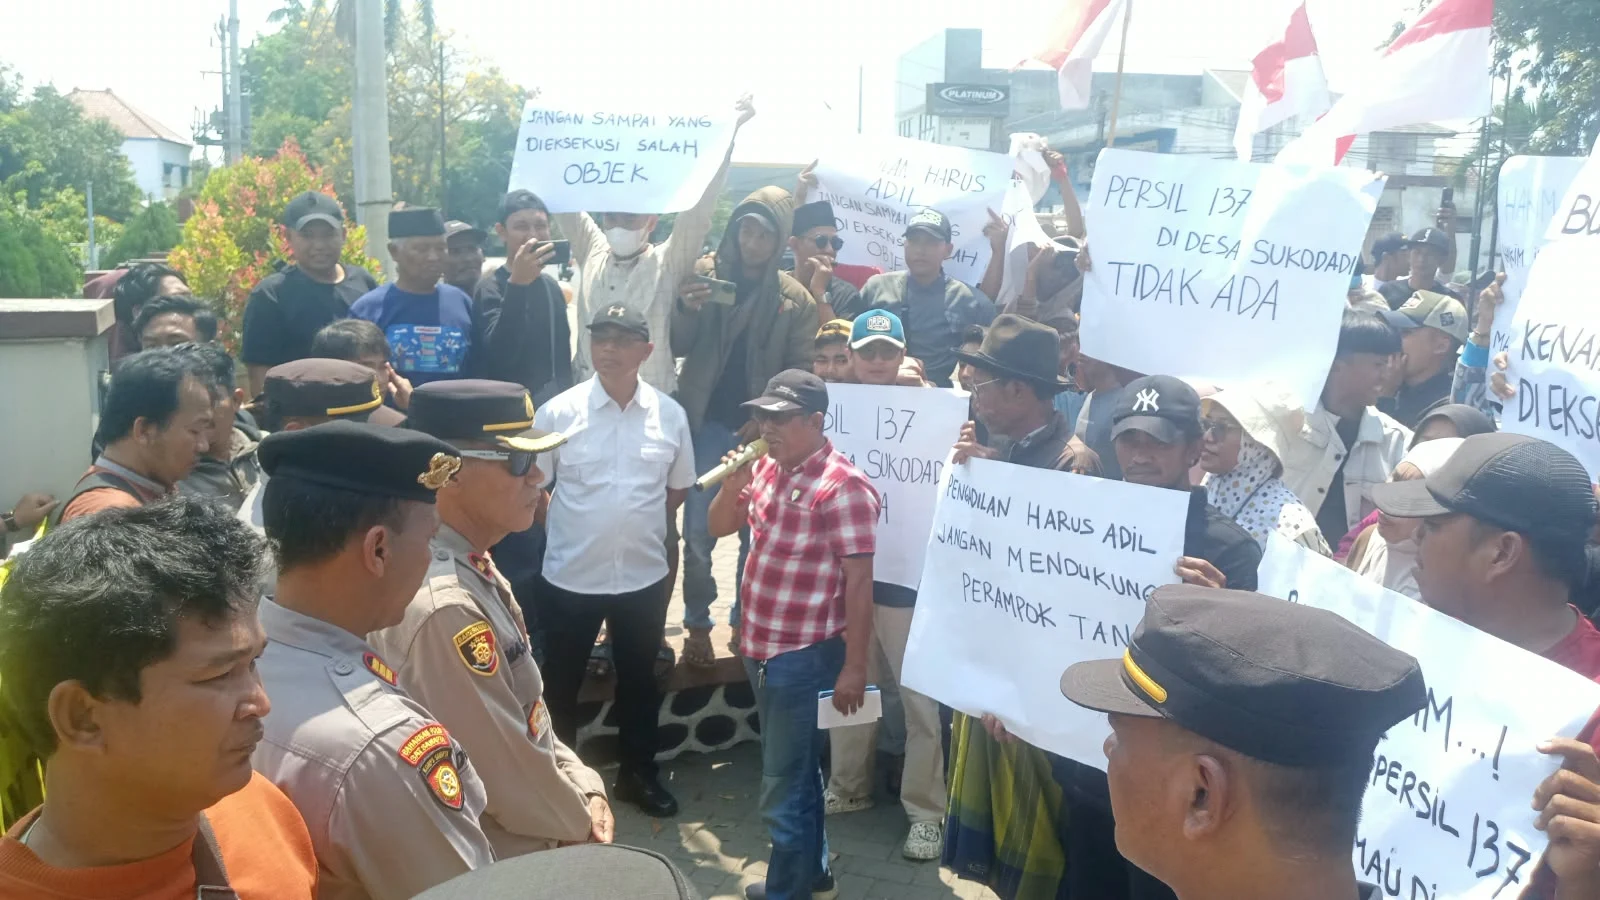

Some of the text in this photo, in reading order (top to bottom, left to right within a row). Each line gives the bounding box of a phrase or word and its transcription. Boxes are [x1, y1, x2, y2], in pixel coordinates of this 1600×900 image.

[948, 90, 998, 99] PLATINUM
[527, 110, 712, 128] JANGAN SAMPAI YANG
[637, 139, 698, 158] SALAH
[563, 161, 648, 185] OBJEK
[924, 165, 986, 193] HARUS
[865, 178, 930, 208] ADIL
[1104, 175, 1253, 217] PERSIL 137
[864, 202, 907, 225] SAMPAI
[1156, 226, 1358, 275] DI DESA SUKODADI
[1107, 261, 1279, 320] TIDAK ADA
[876, 405, 916, 443] 137
[864, 449, 945, 485] SUKODAD
[1027, 501, 1095, 535] HARUS
[937, 523, 992, 560] JANGAN
[962, 572, 1131, 647] PERAMPOK TAN
[1467, 813, 1531, 899] 137
